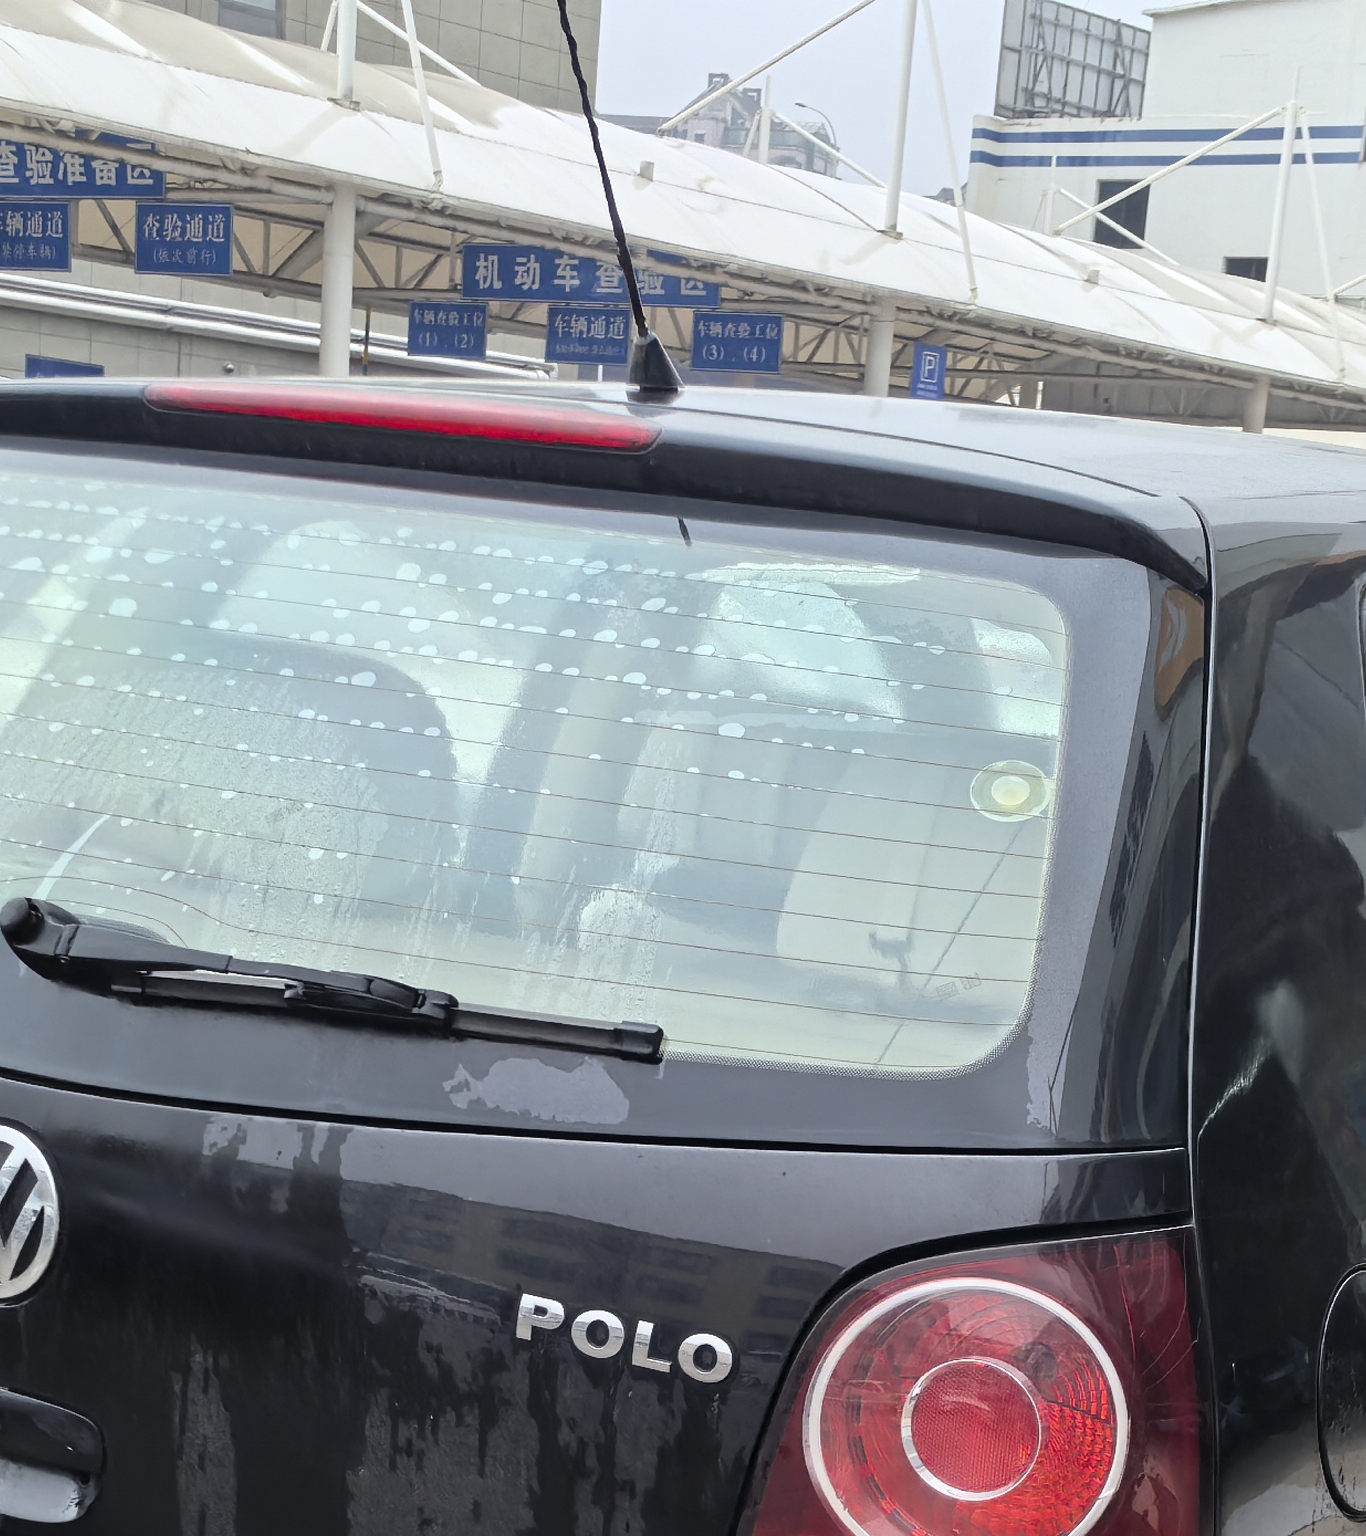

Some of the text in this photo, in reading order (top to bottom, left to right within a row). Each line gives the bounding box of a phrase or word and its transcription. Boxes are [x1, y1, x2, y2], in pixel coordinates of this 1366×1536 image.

[143, 213, 226, 242] 查验通道
[414, 308, 483, 328] 车辆查验工位
[555, 313, 626, 340] 车辆通道
[698, 320, 779, 341] 车辆查验工位
[515, 1292, 733, 1384] POLO
